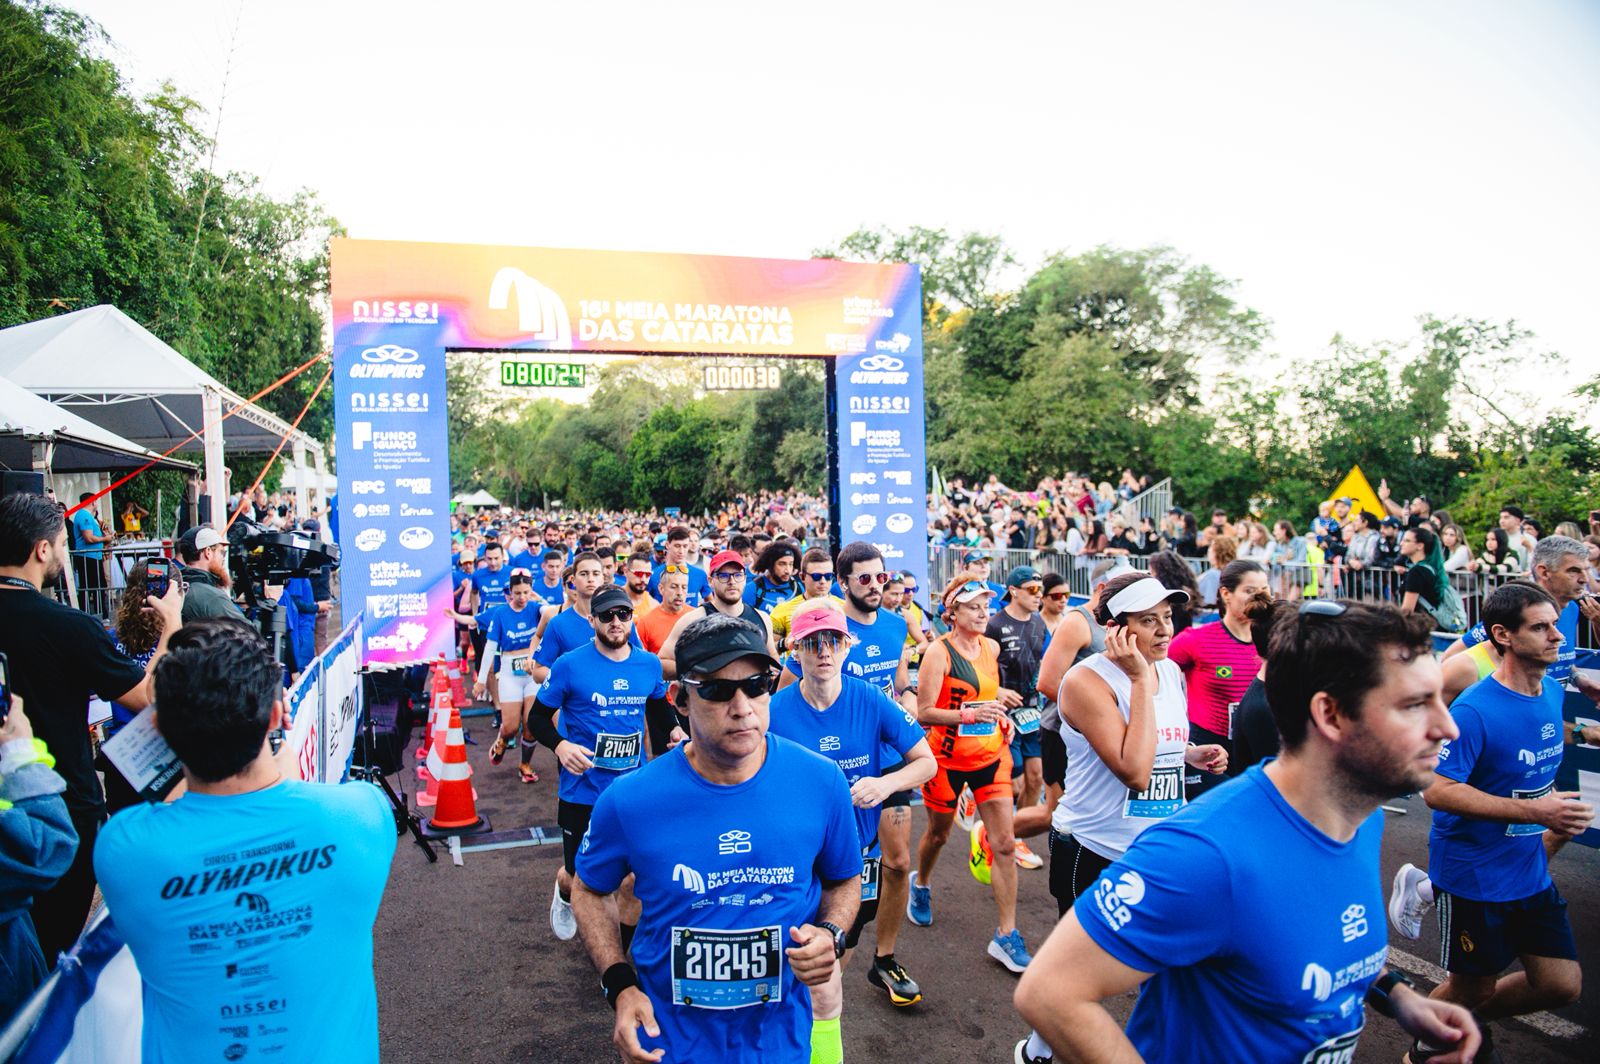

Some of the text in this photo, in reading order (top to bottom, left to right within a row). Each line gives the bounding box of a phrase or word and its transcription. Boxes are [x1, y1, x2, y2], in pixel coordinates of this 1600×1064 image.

[616, 301, 671, 321] MEIA
[676, 303, 793, 325] MARATONA
[579, 319, 794, 346] DAS CATARATAS
[349, 364, 426, 379] OLYMPIKUS
[503, 363, 584, 386] 080024
[373, 431, 417, 441] FUNDO
[373, 440, 417, 451] IGUAÇU
[352, 480, 386, 494] RPC
[850, 473, 877, 485] RPC
[368, 504, 390, 514] CCR
[602, 740, 638, 759] 21441
[1138, 773, 1179, 800] 1370
[718, 841, 752, 856] 50
[160, 844, 337, 901] OLYMPIKUS
[708, 873, 795, 890] DAS CATARATAS
[723, 869, 745, 879] MEIA
[746, 866, 794, 876] MARATONA
[188, 912, 314, 941] DAS CATARATAS
[208, 920, 239, 932] MEIA
[243, 904, 313, 925] MARATONA
[686, 941, 768, 981] 21245
